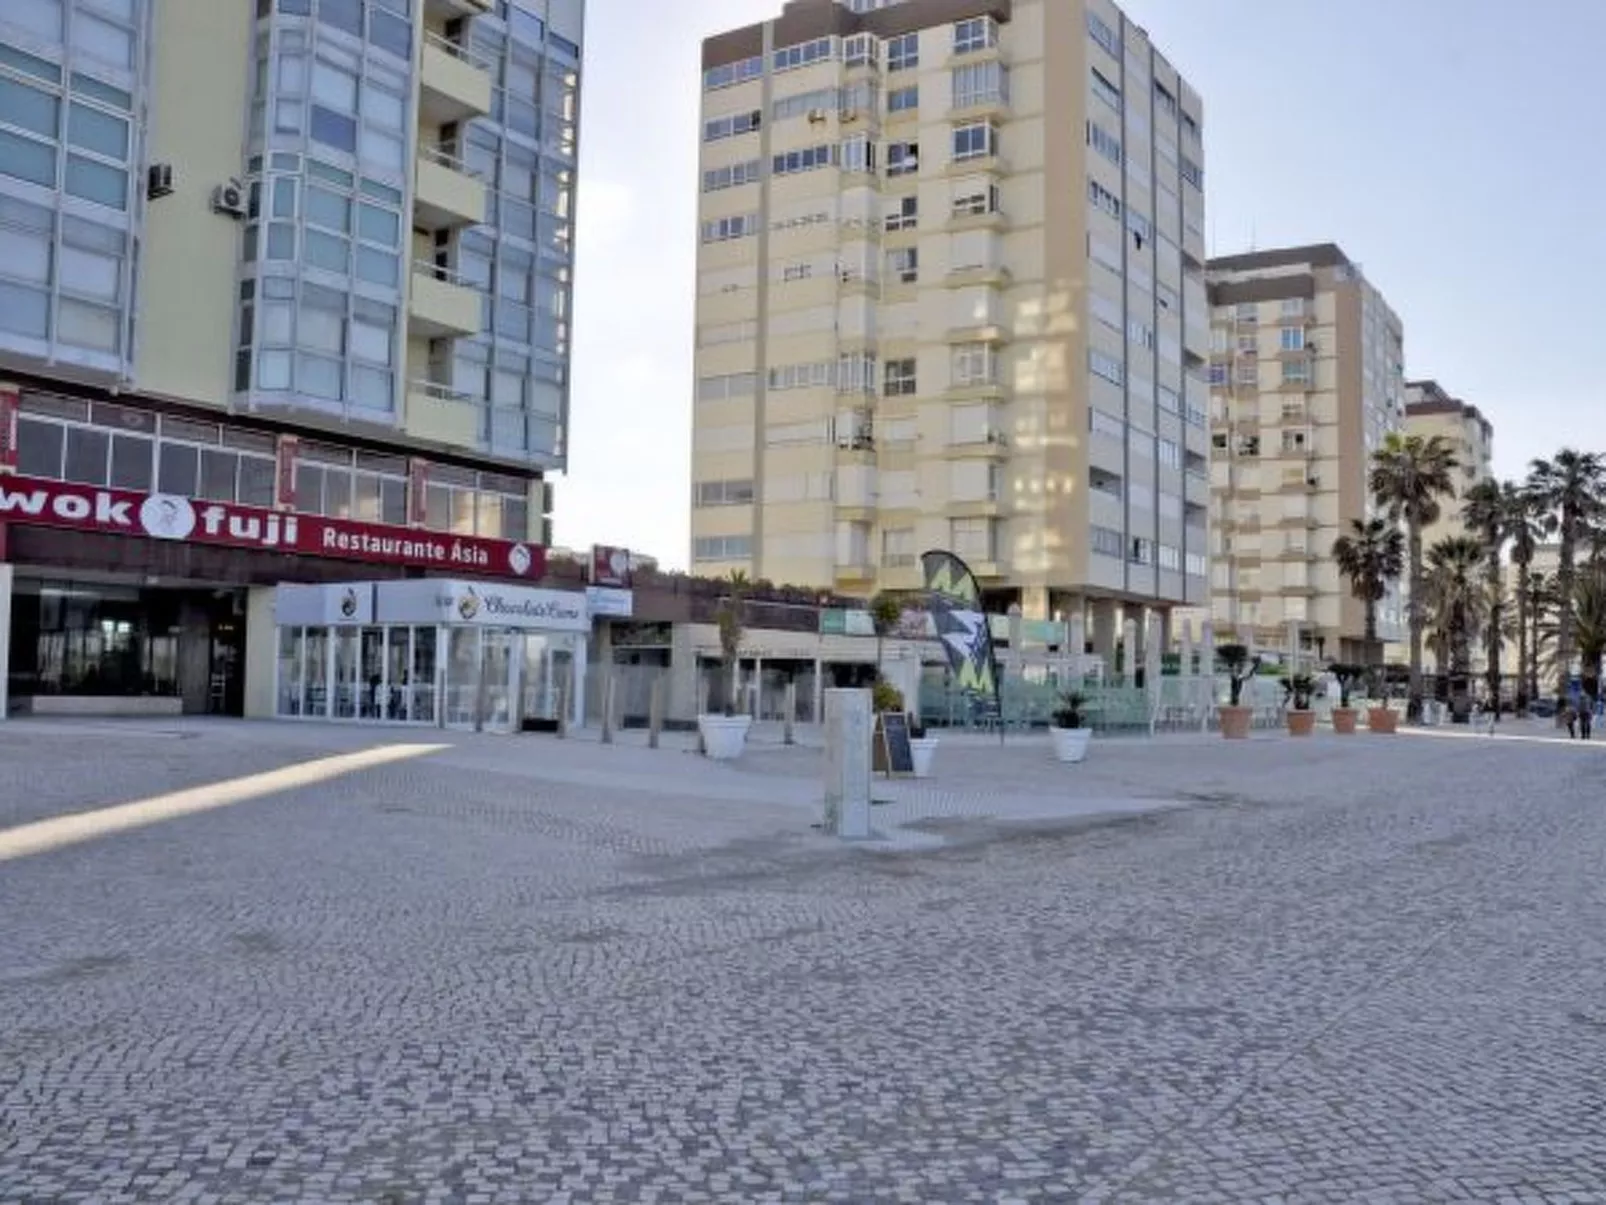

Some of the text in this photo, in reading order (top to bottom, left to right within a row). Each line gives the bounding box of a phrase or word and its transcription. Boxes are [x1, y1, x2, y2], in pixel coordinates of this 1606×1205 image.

[0, 486, 298, 545] wok fuji
[322, 526, 488, 565] Restaurante Ásia
